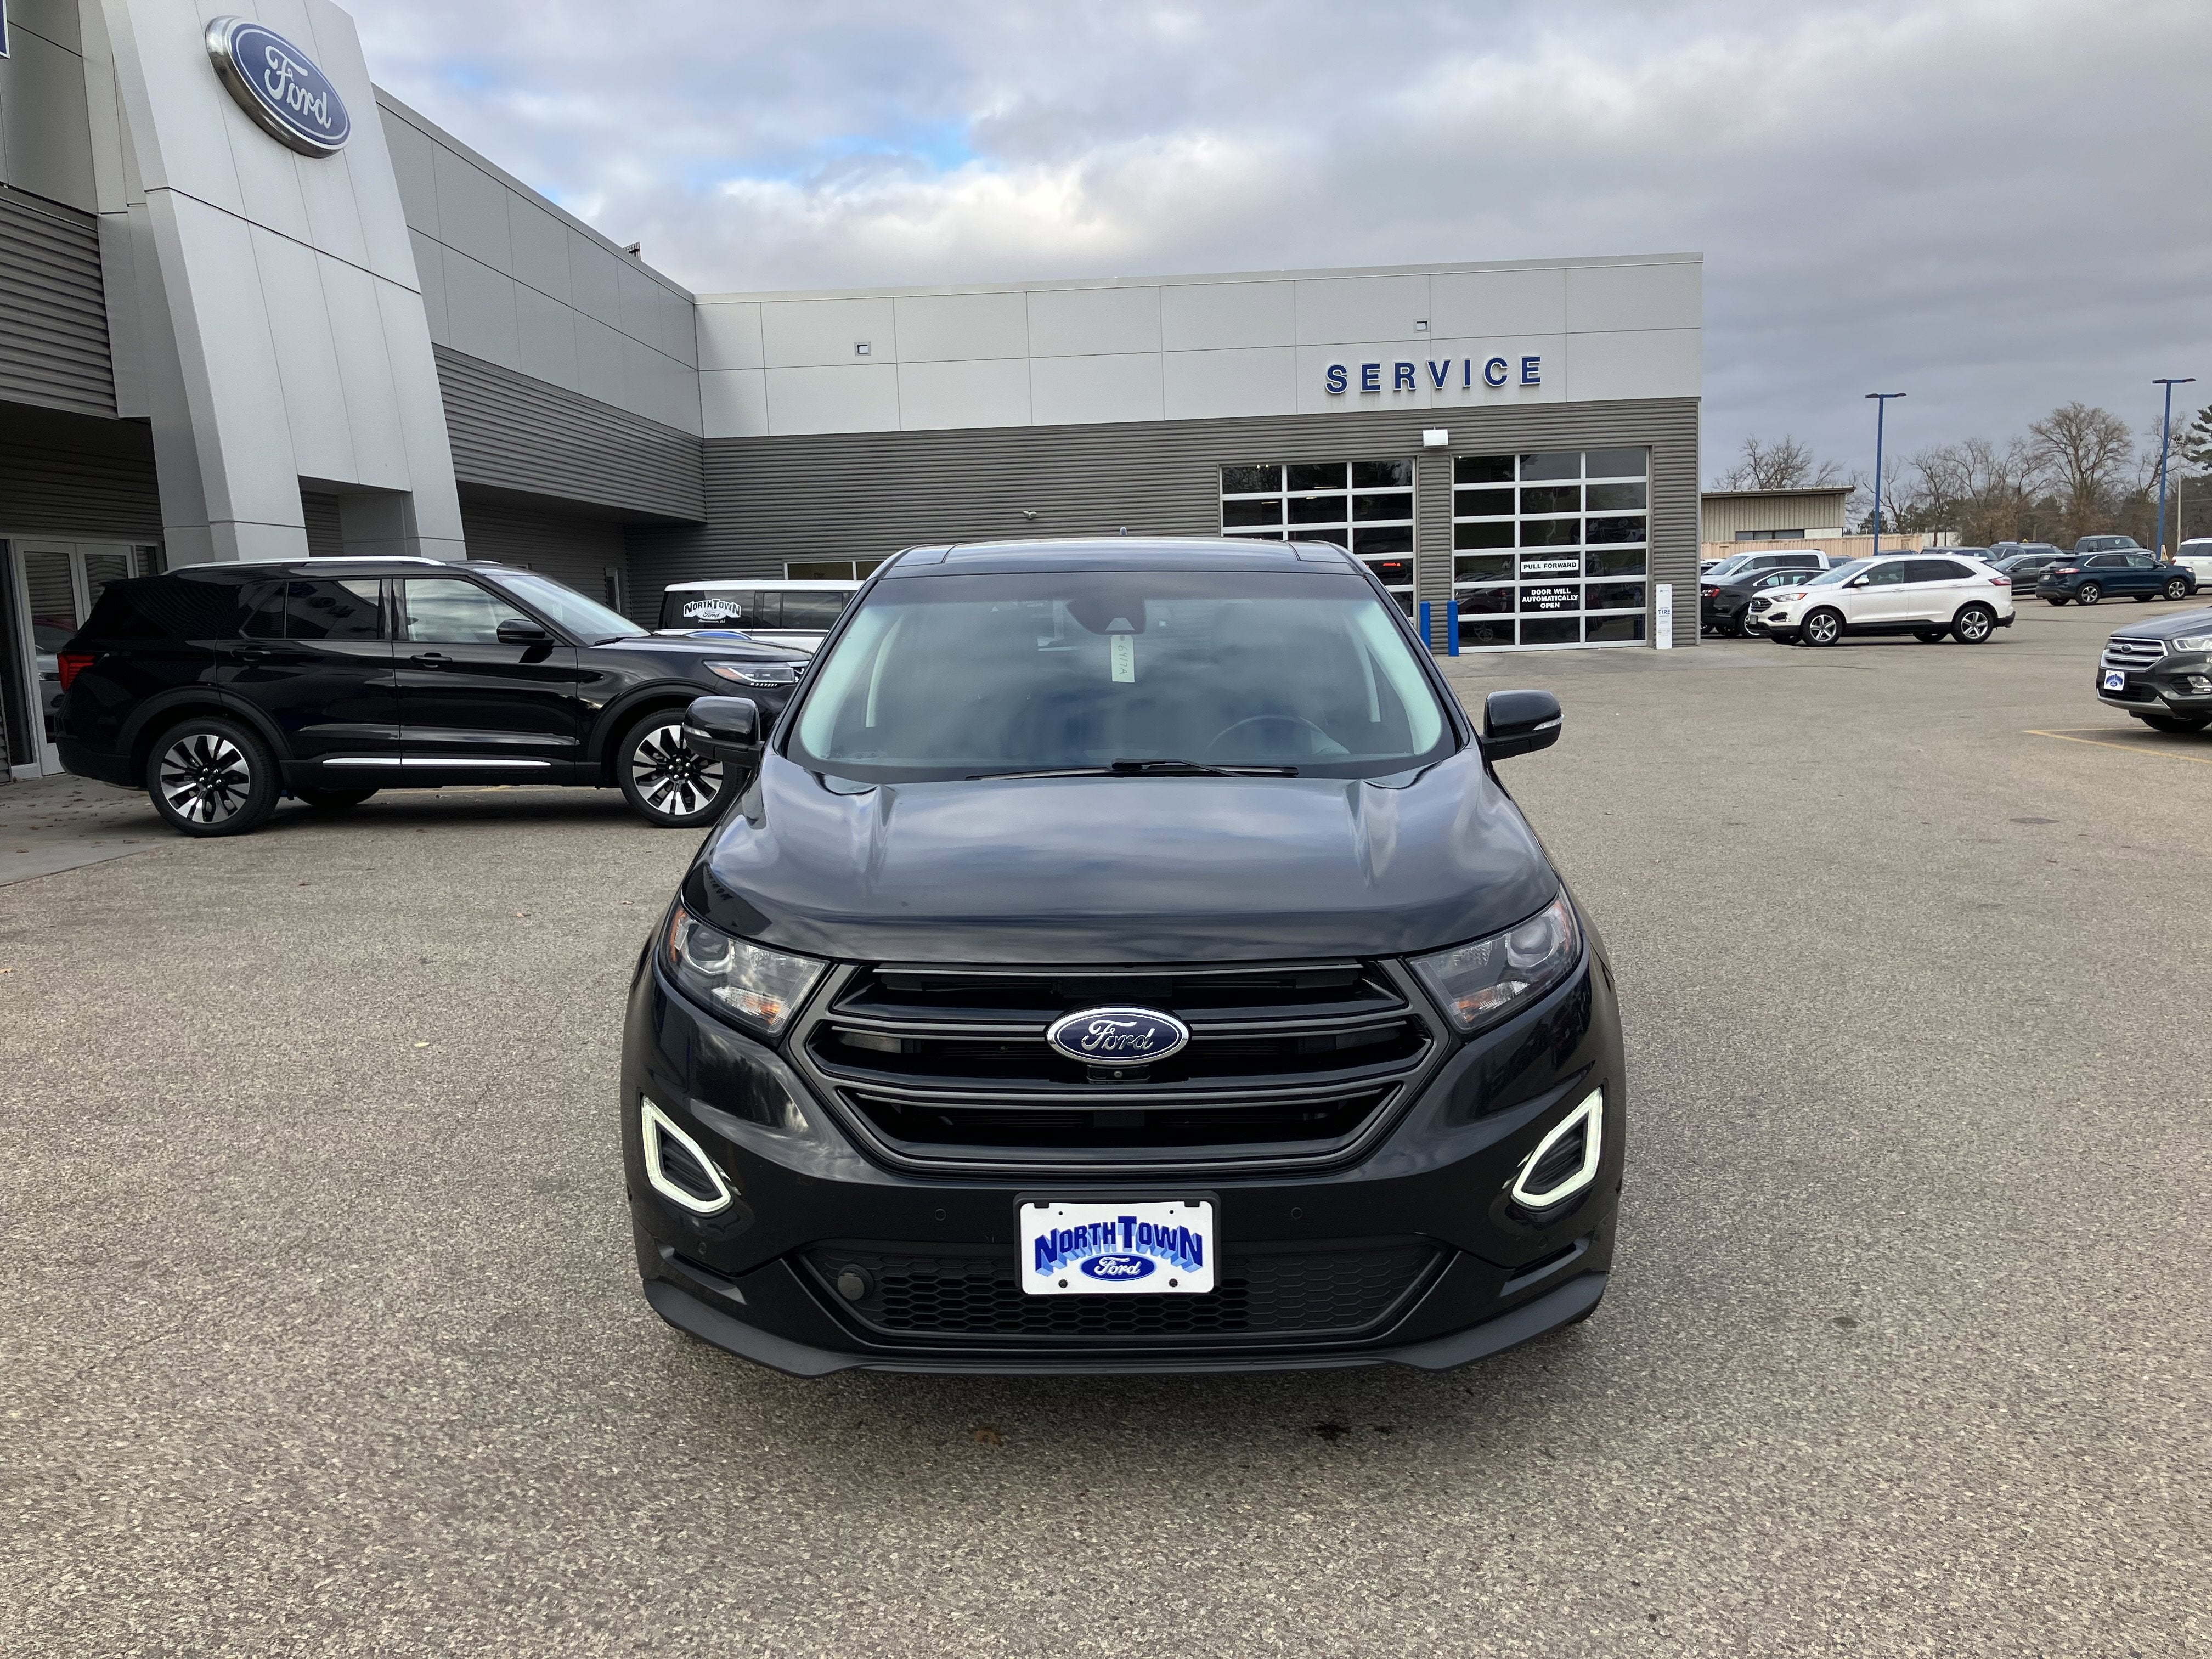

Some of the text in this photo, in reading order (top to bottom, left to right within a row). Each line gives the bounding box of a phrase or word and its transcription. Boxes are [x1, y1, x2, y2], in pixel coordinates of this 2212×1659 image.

[264, 46, 331, 129] Ford
[1325, 356, 1541, 394] SERVICE
[1521, 594, 1579, 602] AUTOMATICALLY
[1118, 645, 1128, 675] 6417A
[1081, 1020, 1155, 1050] Ford
[1094, 1256, 1142, 1276] Ford
